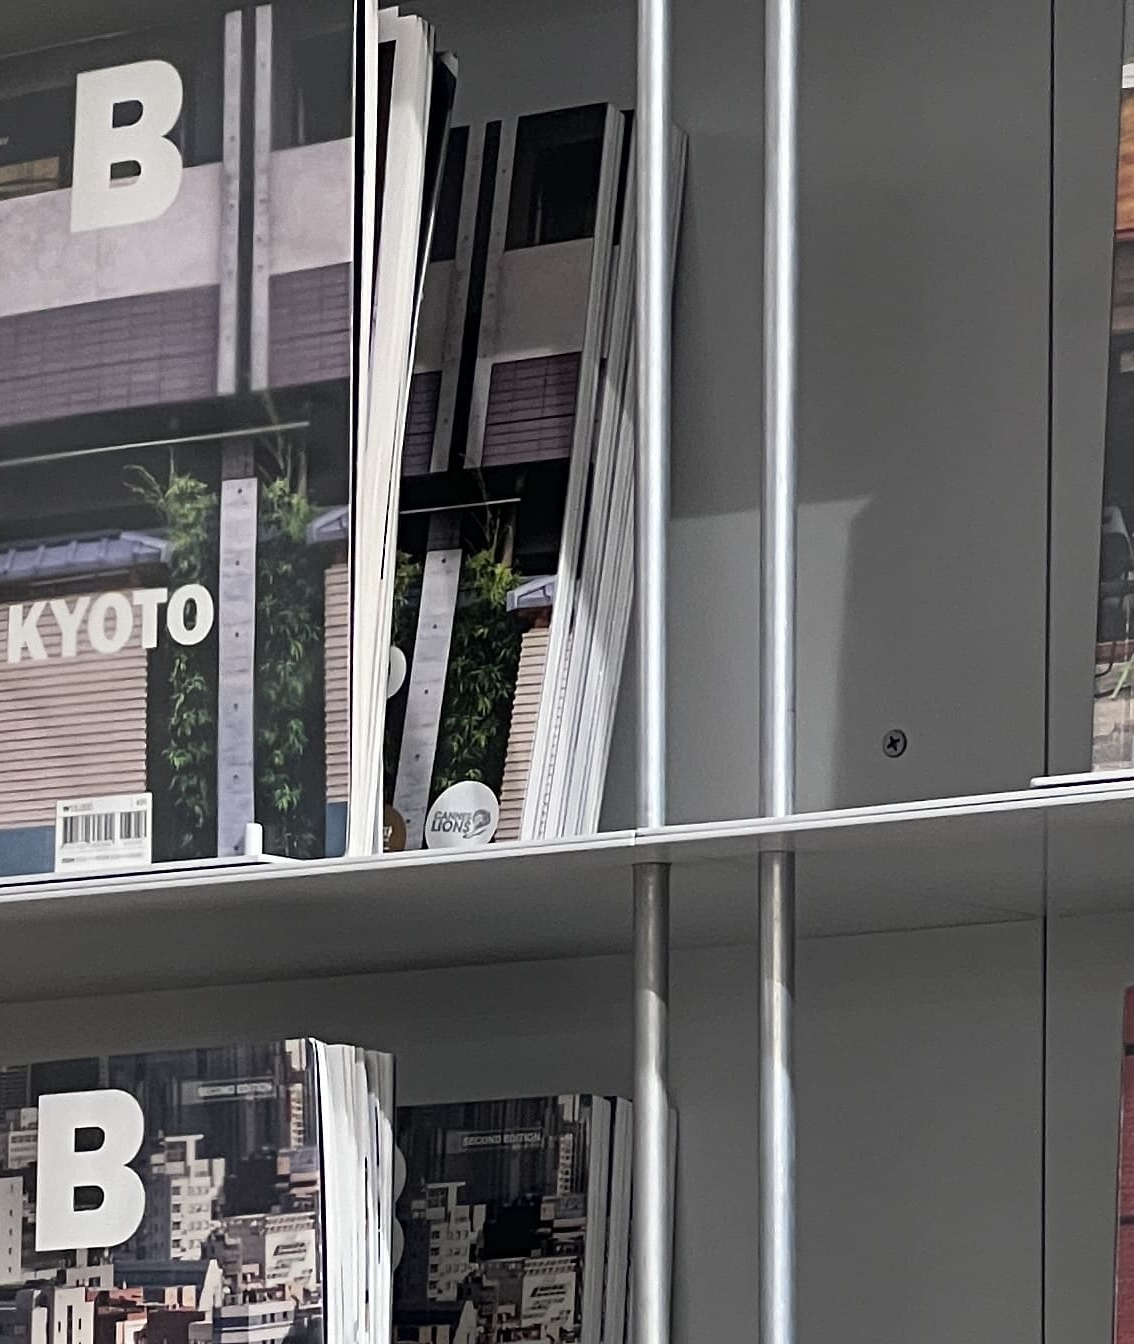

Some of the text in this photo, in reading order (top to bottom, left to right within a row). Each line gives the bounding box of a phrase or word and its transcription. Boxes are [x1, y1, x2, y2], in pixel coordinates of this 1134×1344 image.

[70, 59, 184, 233] B
[7, 583, 215, 664] KYOTO
[35, 1089, 146, 1252] B
[463, 1132, 541, 1146] SECOND EDITION
